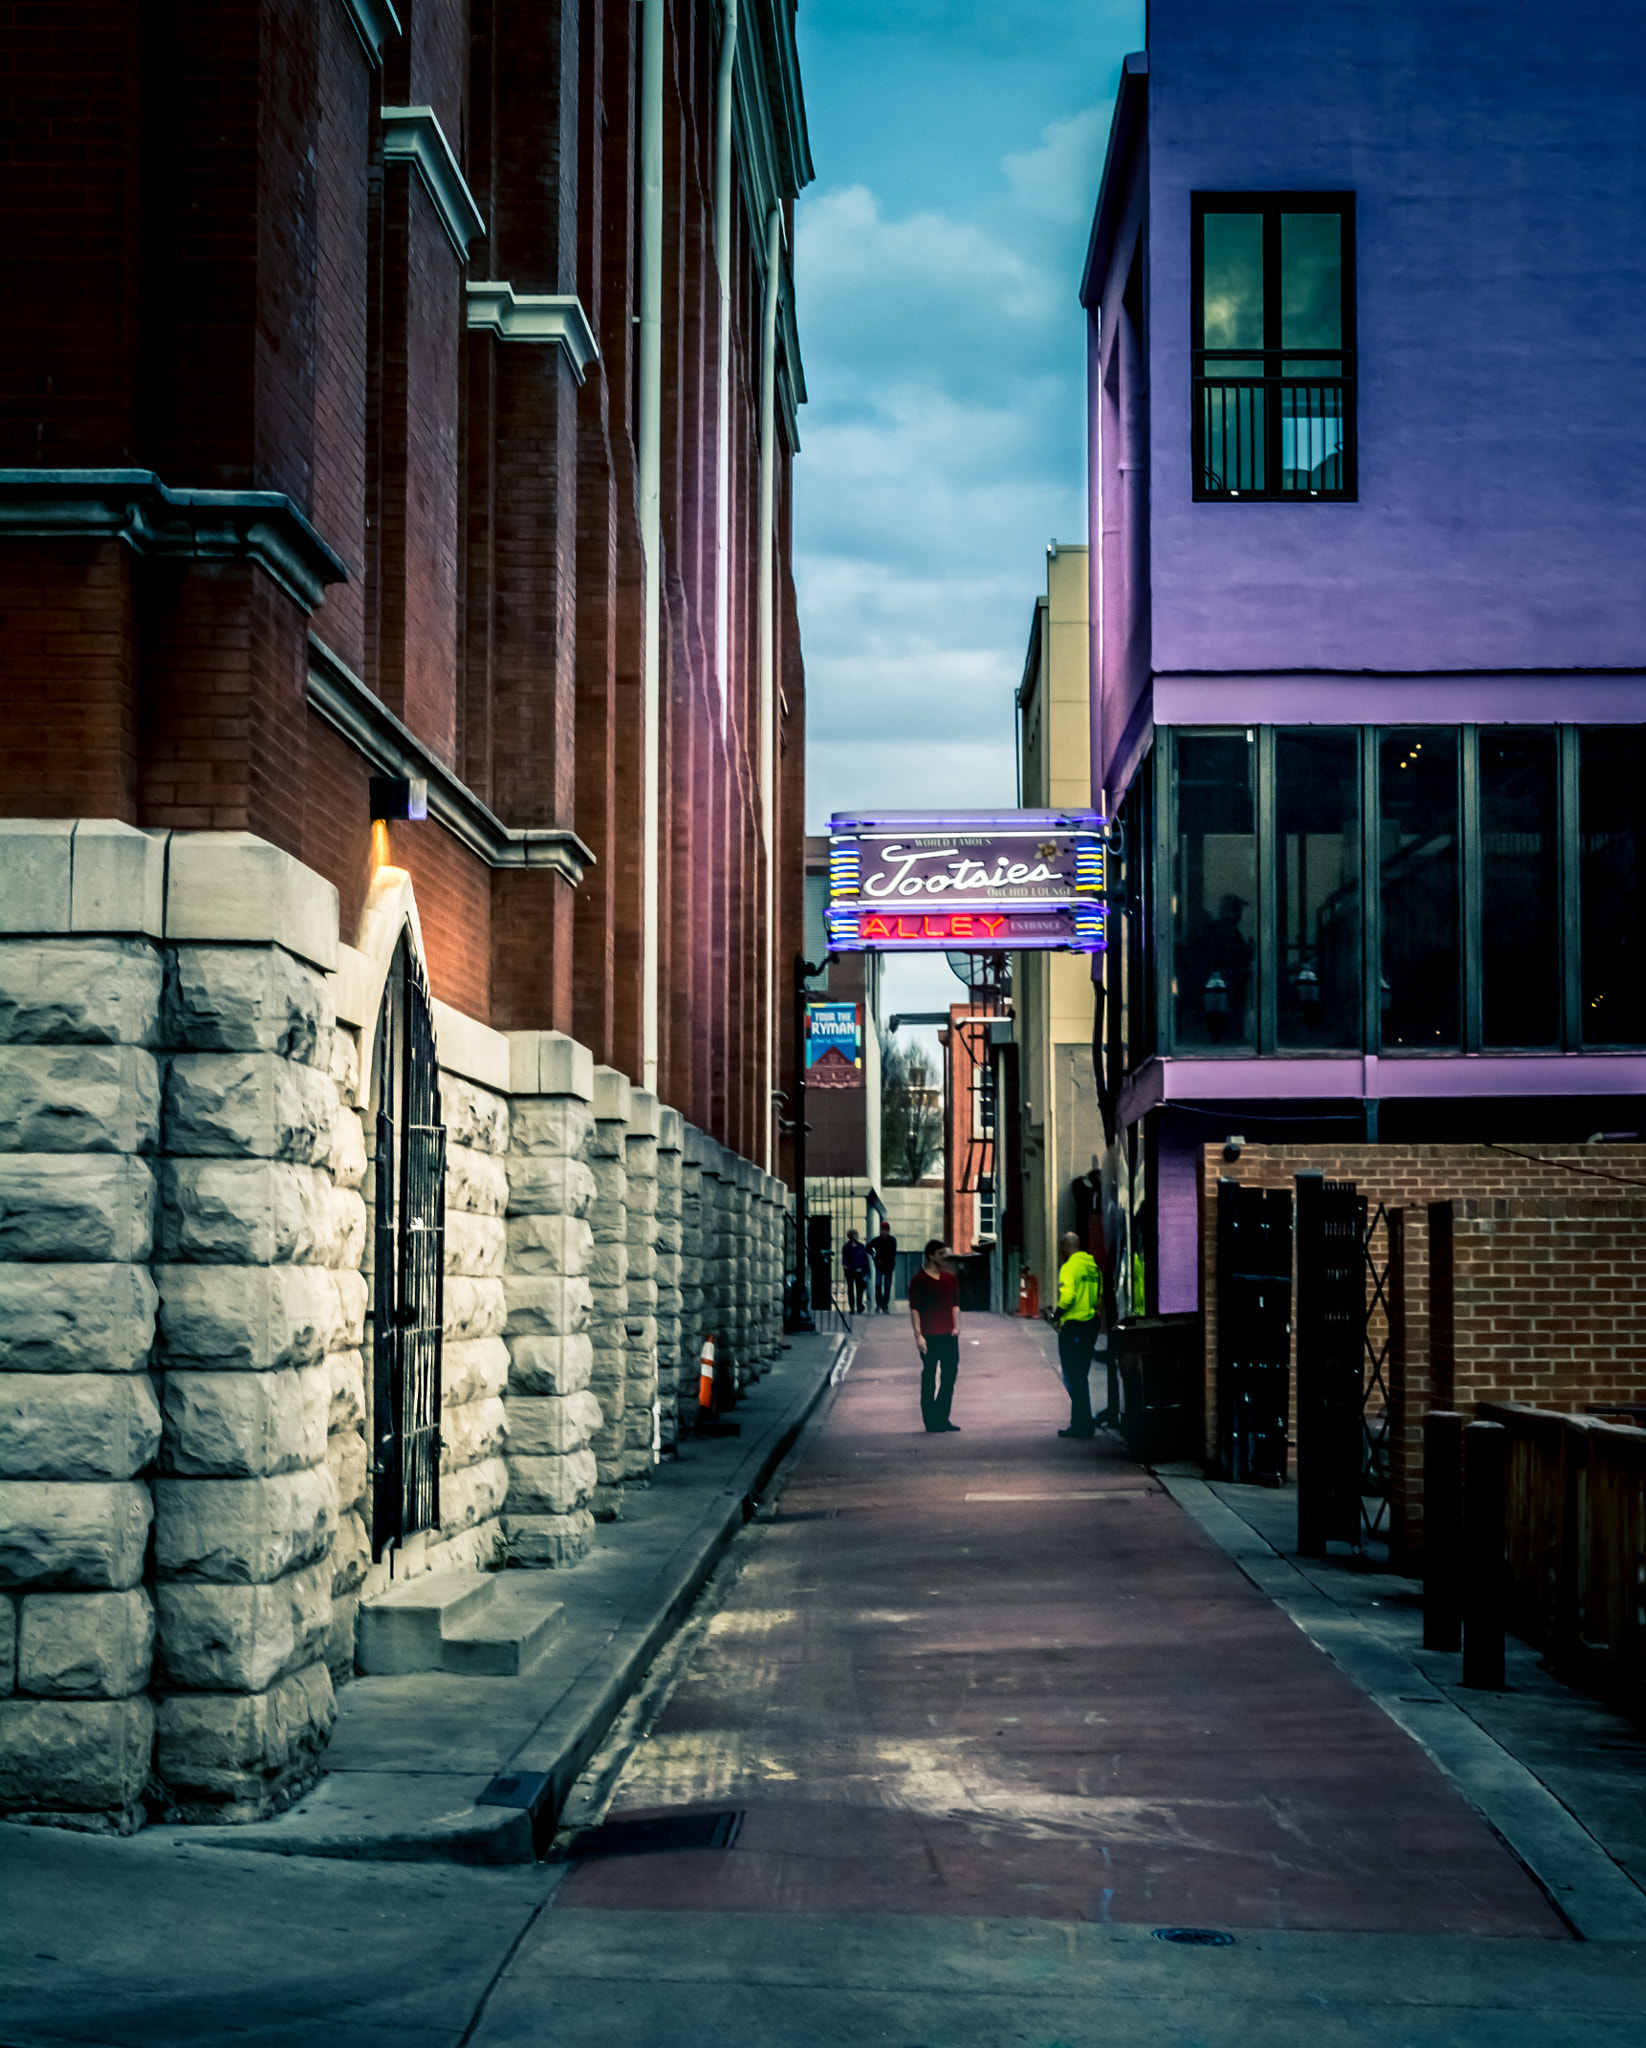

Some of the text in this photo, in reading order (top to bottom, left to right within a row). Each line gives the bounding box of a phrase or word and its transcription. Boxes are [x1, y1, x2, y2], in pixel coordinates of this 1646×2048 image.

[915, 837, 992, 847] WORLD FAMOUS
[863, 845, 1063, 896] Tootsies
[987, 887, 1071, 897] ORCHID LOUNGE
[862, 916, 1060, 937] ALLEY ENTRANCE
[815, 1012, 852, 1021] TOUR THE
[812, 1022, 855, 1034] RYMAN
